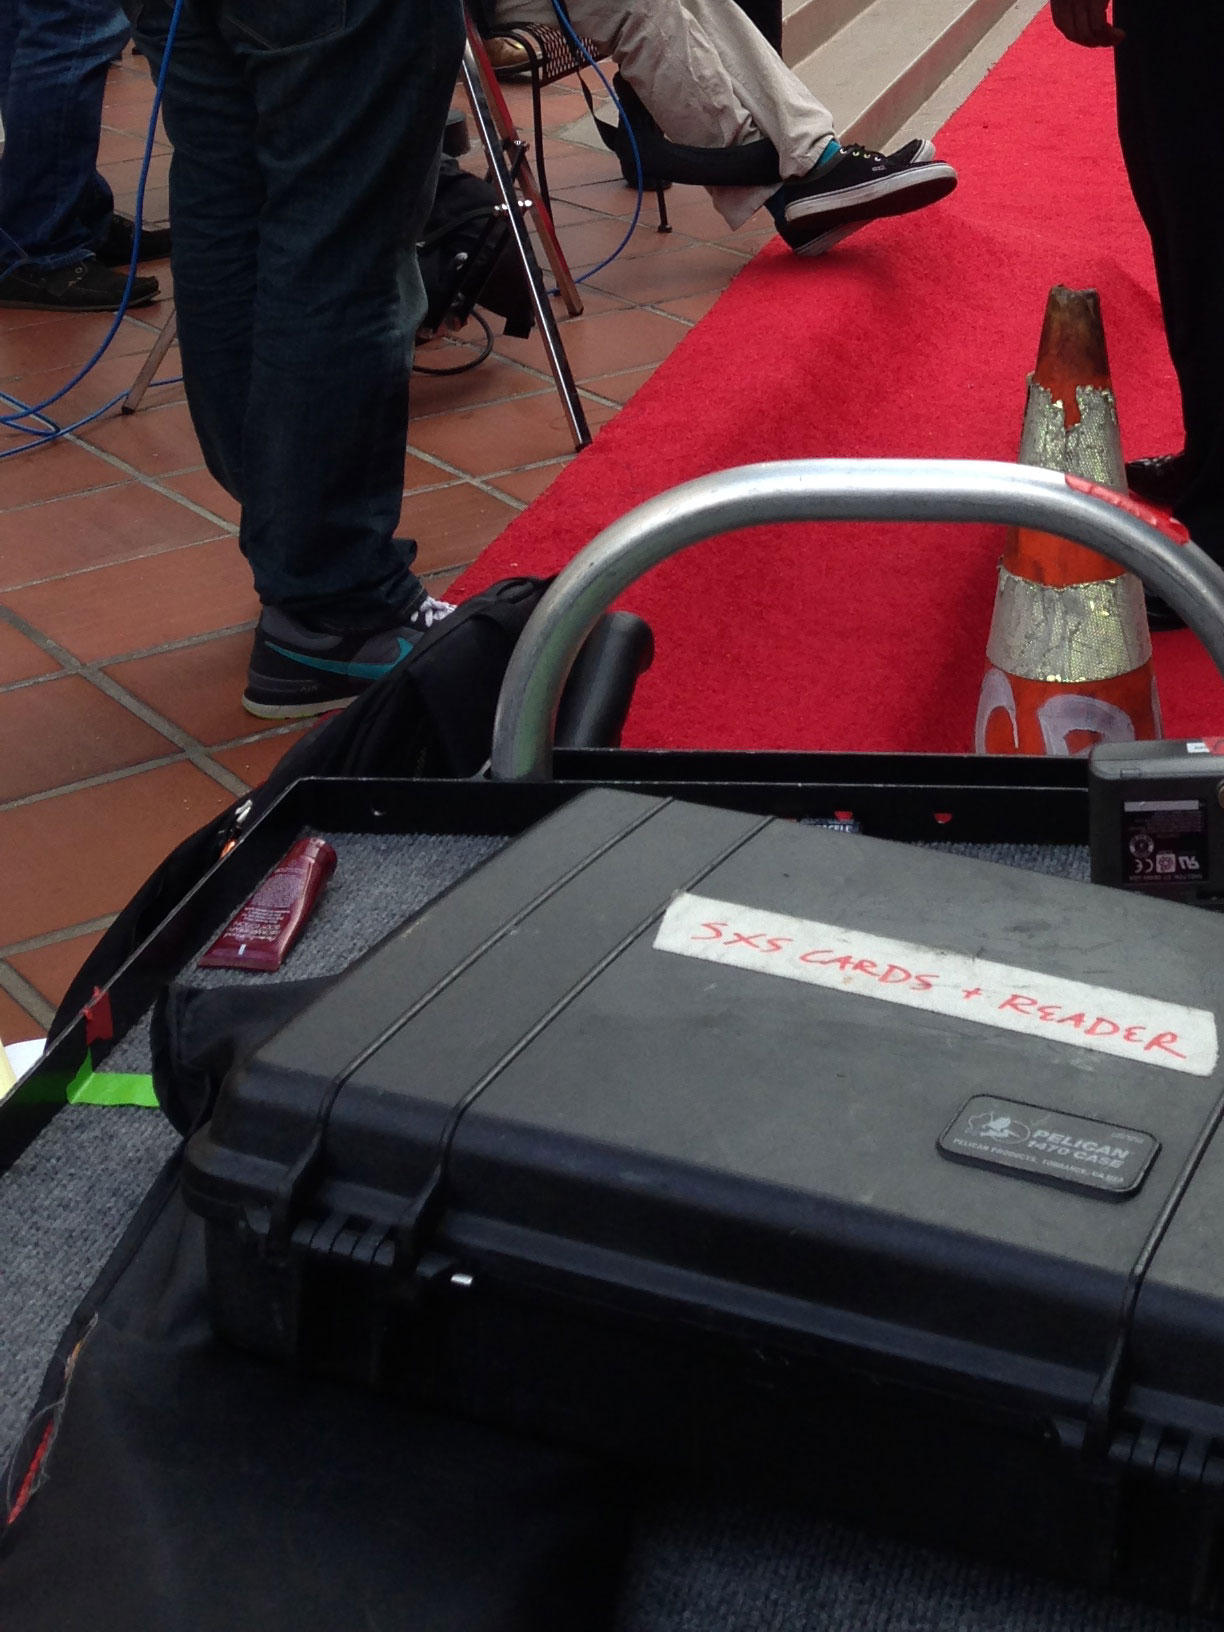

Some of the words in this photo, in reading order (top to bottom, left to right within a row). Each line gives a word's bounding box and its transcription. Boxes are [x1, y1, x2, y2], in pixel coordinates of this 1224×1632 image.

[800, 949, 940, 992] CARDS
[997, 993, 1188, 1060] READER
[953, 1138, 990, 1151] PELICAN
[1027, 1140, 1069, 1155] 1470
[1073, 1150, 1124, 1169] CASE
[1032, 1129, 1130, 1158] PELICAN
